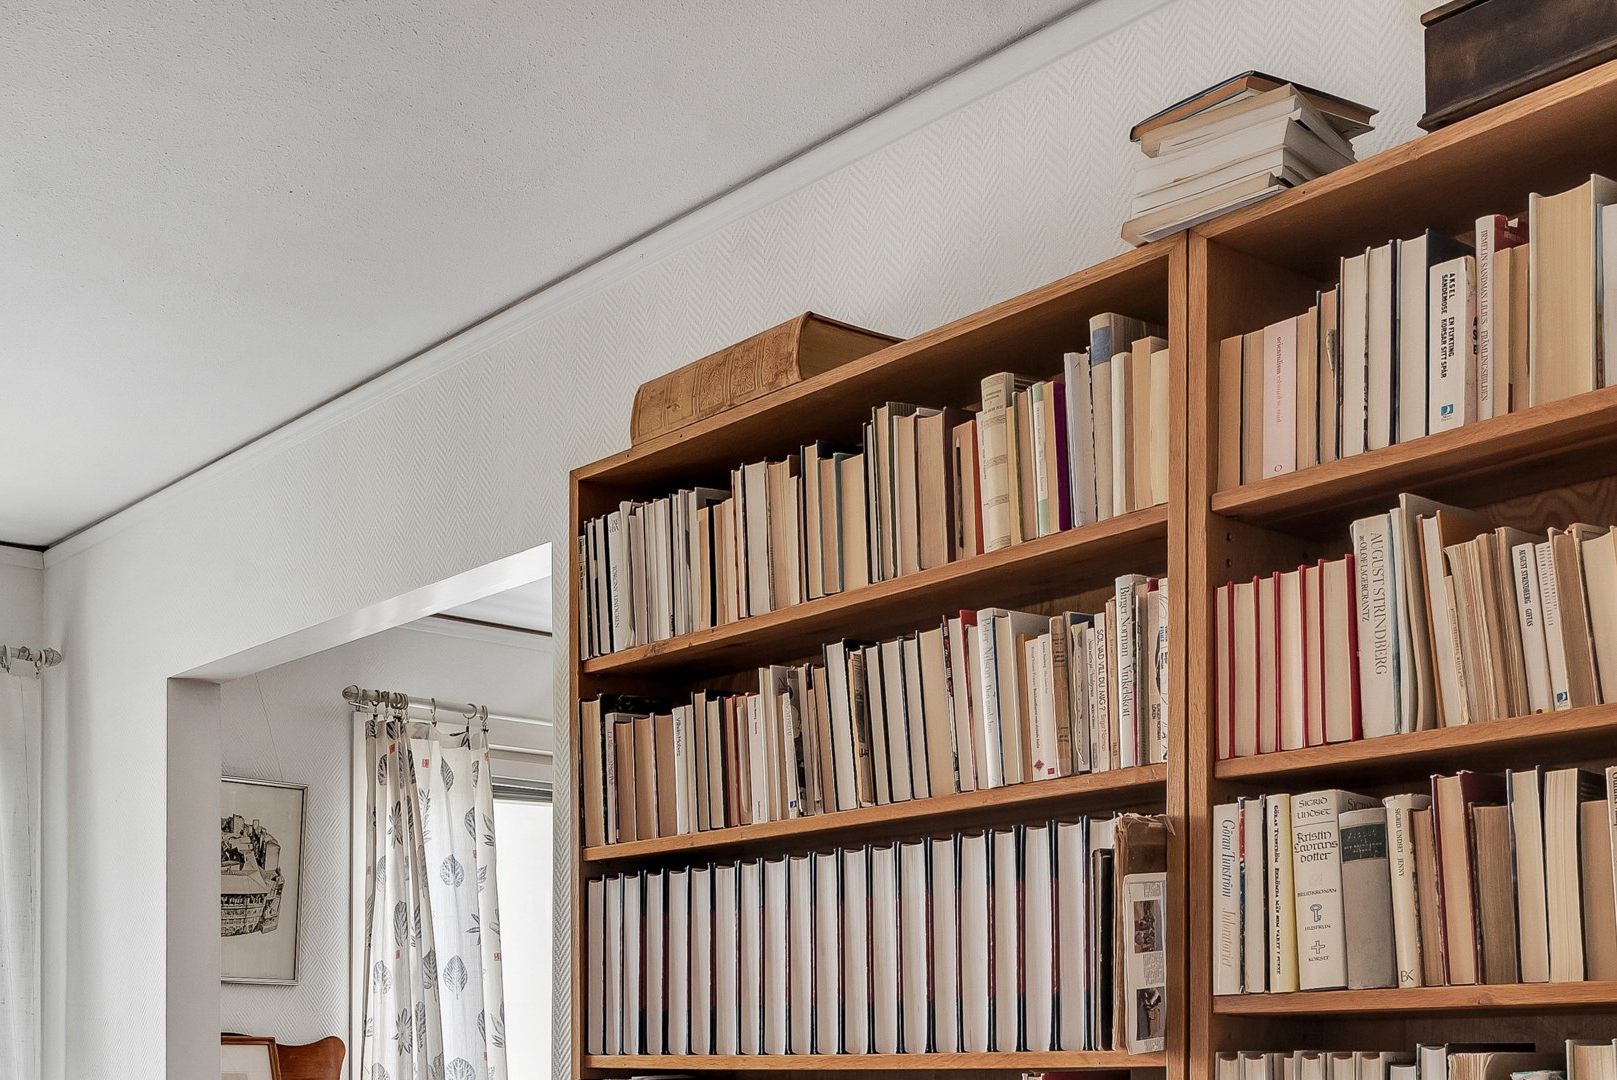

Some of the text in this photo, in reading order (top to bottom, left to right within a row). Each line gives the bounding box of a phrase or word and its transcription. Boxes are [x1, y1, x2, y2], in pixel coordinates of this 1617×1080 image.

[1480, 230, 1488, 261] IRMELIN
[1448, 273, 1456, 299] AKSEL
[1480, 262, 1488, 299] SANDMAN
[1448, 317, 1455, 326] EN
[1480, 300, 1488, 325] LILIUS
[1276, 337, 1284, 375] orientalism
[1441, 361, 1449, 378] SPÅR
[1359, 542, 1368, 564] OLOF
[1360, 564, 1370, 622] LAGERCRANTZ
[1519, 550, 1533, 627] AUGUST STRINDBERG GIFTAS
[1370, 532, 1388, 676] AUGUST STRINDBERG
[981, 618, 991, 642] Peter
[982, 646, 994, 678] Nilson
[1097, 647, 1105, 660] VAD
[1119, 586, 1133, 717] Birger Norman Vinkelskott
[985, 684, 993, 696] Den
[1098, 676, 1106, 688] DU
[1297, 808, 1331, 819] UNDSET
[1298, 797, 1328, 808] SIGRID
[1394, 808, 1402, 828] SIGRID
[1221, 819, 1236, 967] Göran Tunström Juloratoriet
